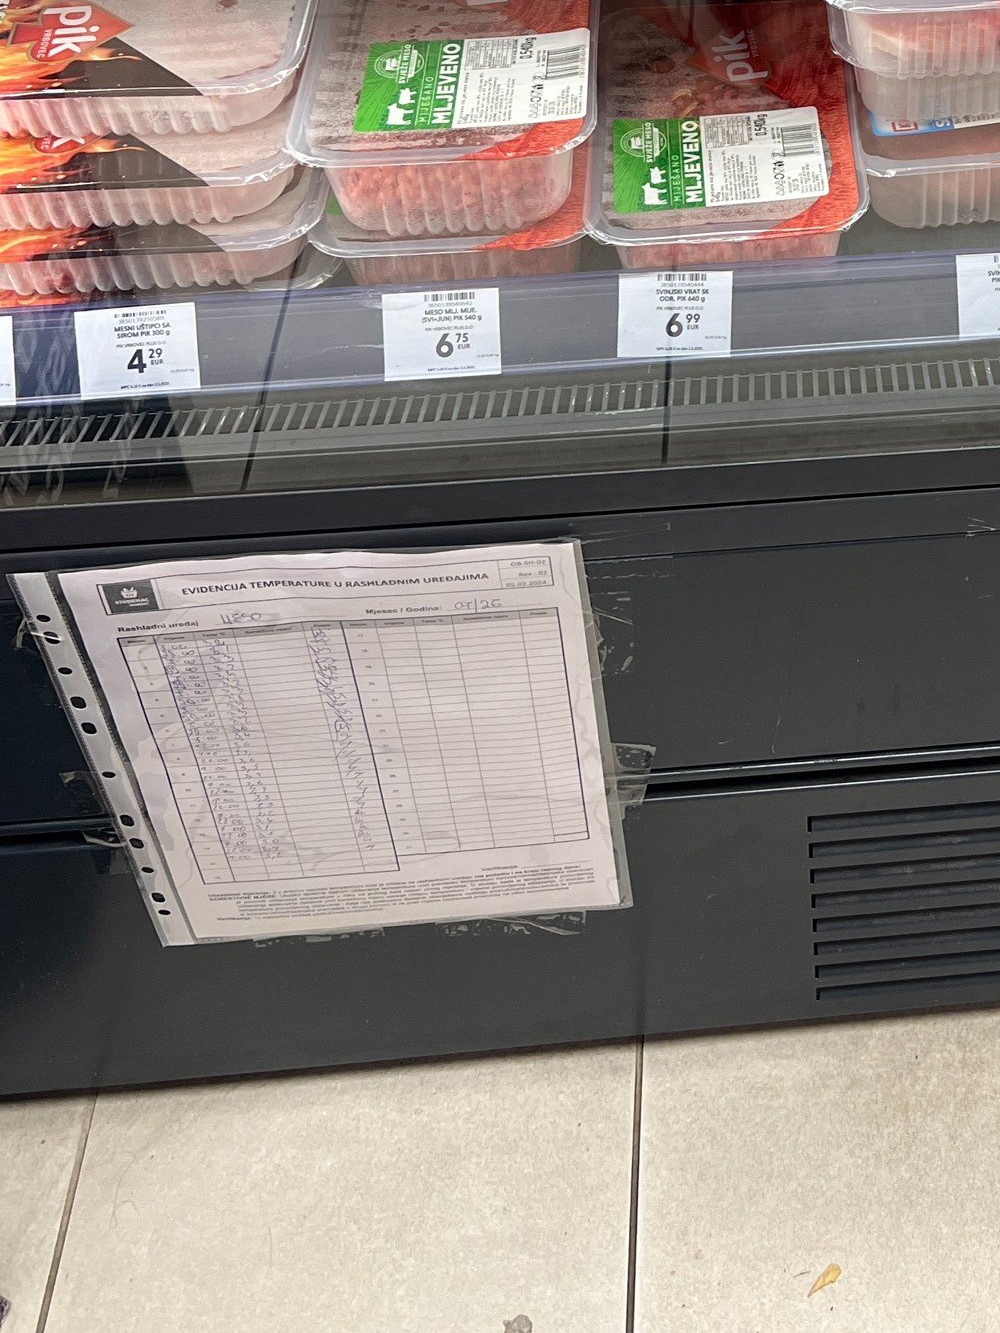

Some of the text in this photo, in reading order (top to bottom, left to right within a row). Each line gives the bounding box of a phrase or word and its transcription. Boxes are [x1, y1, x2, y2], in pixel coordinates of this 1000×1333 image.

[37, 29, 51, 59] VRBOVEC
[42, 5, 100, 58] pik
[401, 44, 412, 61] MESO
[711, 30, 769, 82] pik
[431, 43, 461, 125] MLJEVENO
[418, 76, 435, 124] MIJEŠANO
[644, 122, 652, 142] MESO
[682, 120, 704, 203] MLJEVENO
[671, 155, 682, 203] MIJEŠANO
[114, 325, 135, 333] MESNI
[117, 331, 139, 339] SIROM
[666, 313, 700, 337] 6 99
[436, 333, 469, 358] 6 75
[127, 348, 163, 374] 4 29
[181, 583, 247, 595] EVIDENCIJA
[250, 579, 332, 589] TEMPERATURE
[334, 580, 342, 588] U
[345, 578, 420, 588] RASHLADNIM
[117, 621, 166, 633] Rashladni
